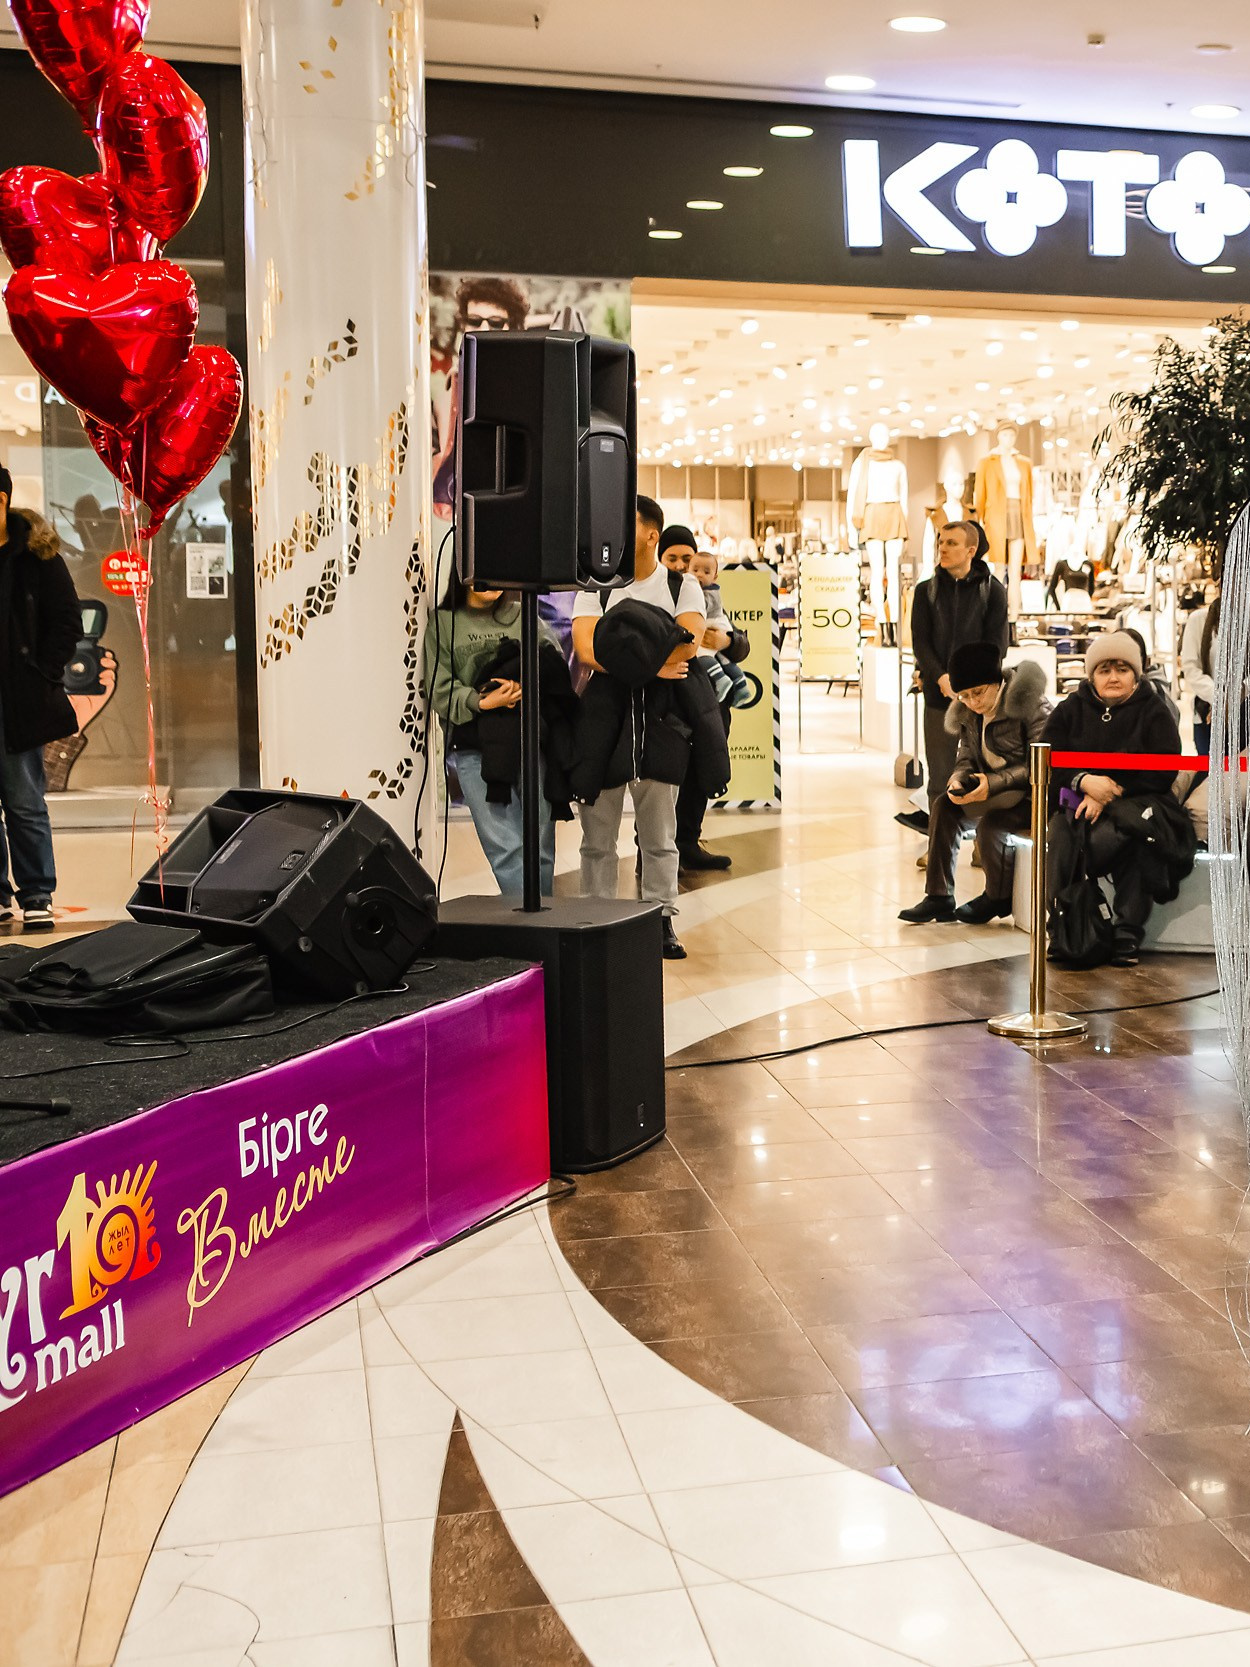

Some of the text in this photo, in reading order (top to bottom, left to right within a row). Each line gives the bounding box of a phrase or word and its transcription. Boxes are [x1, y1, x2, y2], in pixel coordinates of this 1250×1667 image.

[238, 1103, 329, 1179] Бірге
[176, 1135, 356, 1328] Вместе
[34, 1298, 126, 1393] mall
